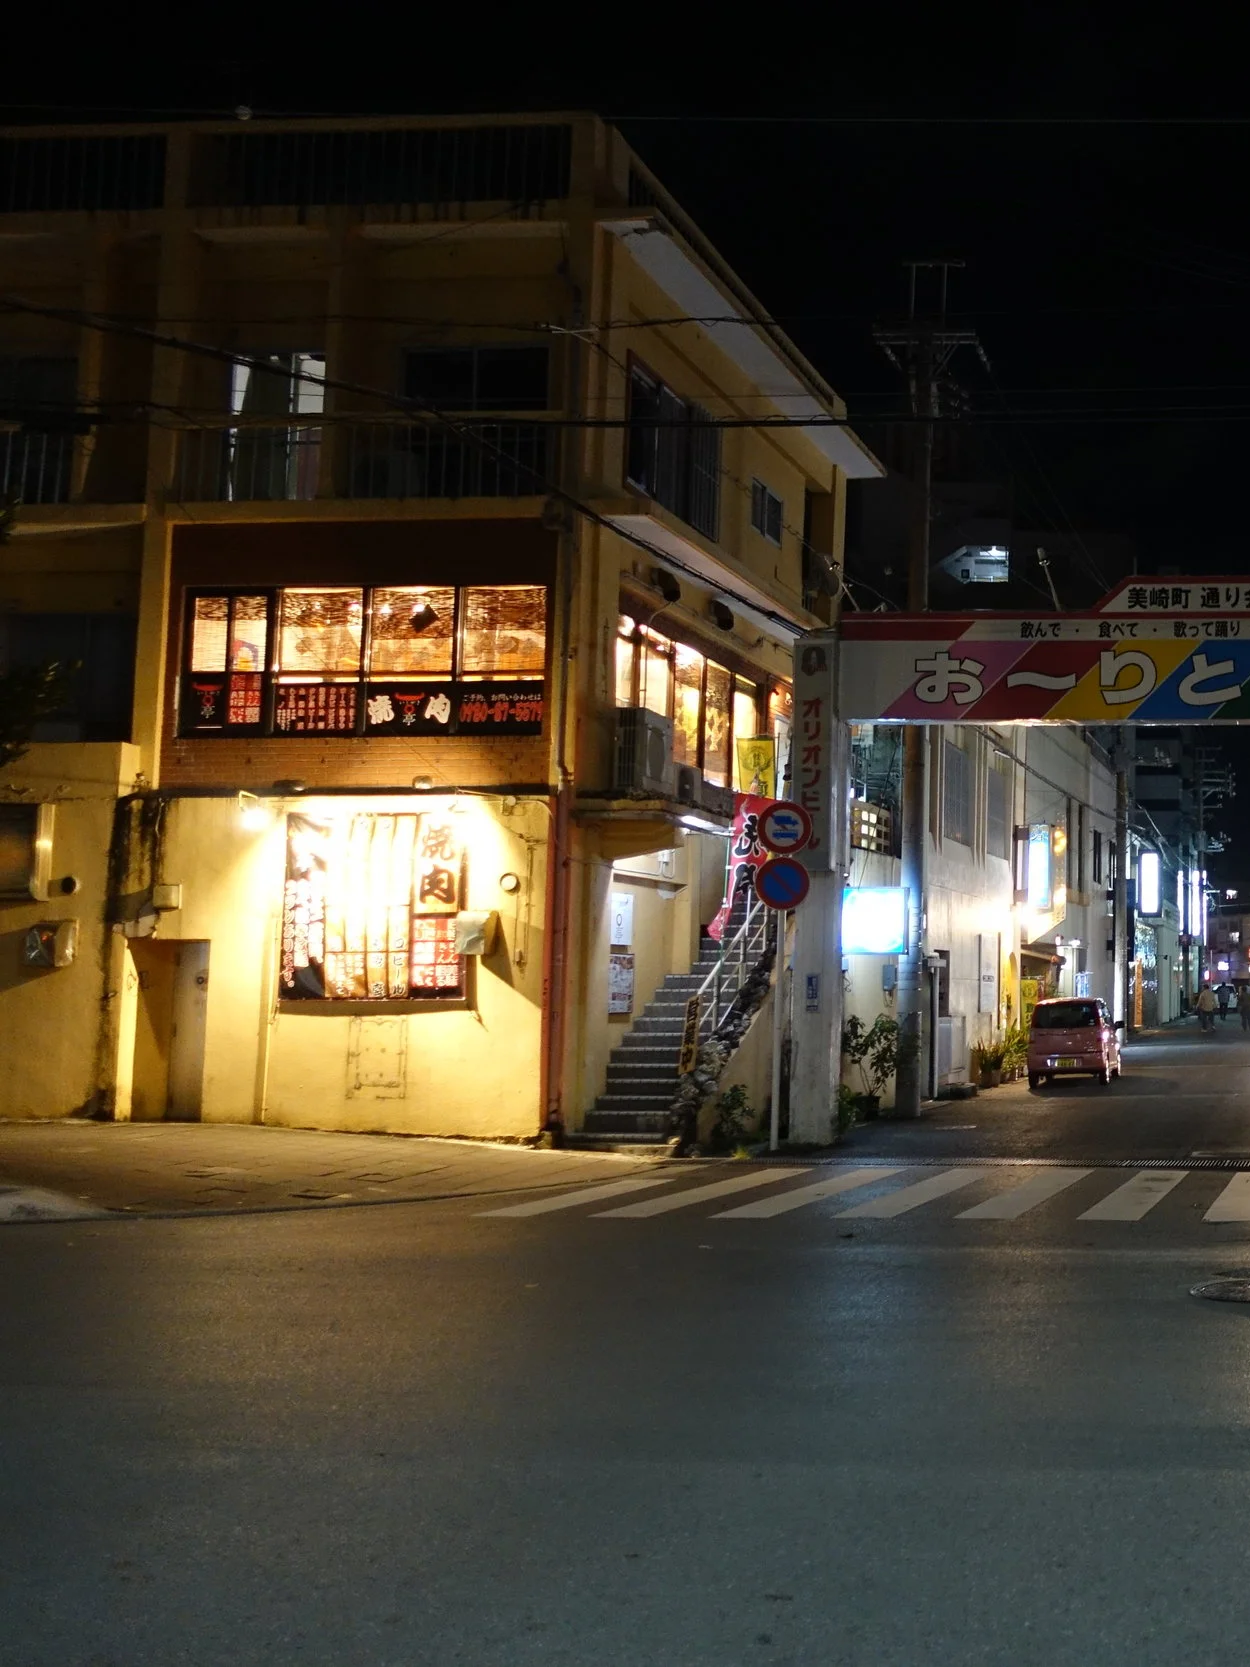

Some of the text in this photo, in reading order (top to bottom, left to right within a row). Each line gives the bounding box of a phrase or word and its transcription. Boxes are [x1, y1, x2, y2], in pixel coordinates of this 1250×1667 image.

[1127, 586, 1191, 610] 美崎町
[1020, 621, 1061, 639] 飲んで
[1097, 621, 1139, 639] 食べて
[1173, 621, 1241, 639] 歌って踊り
